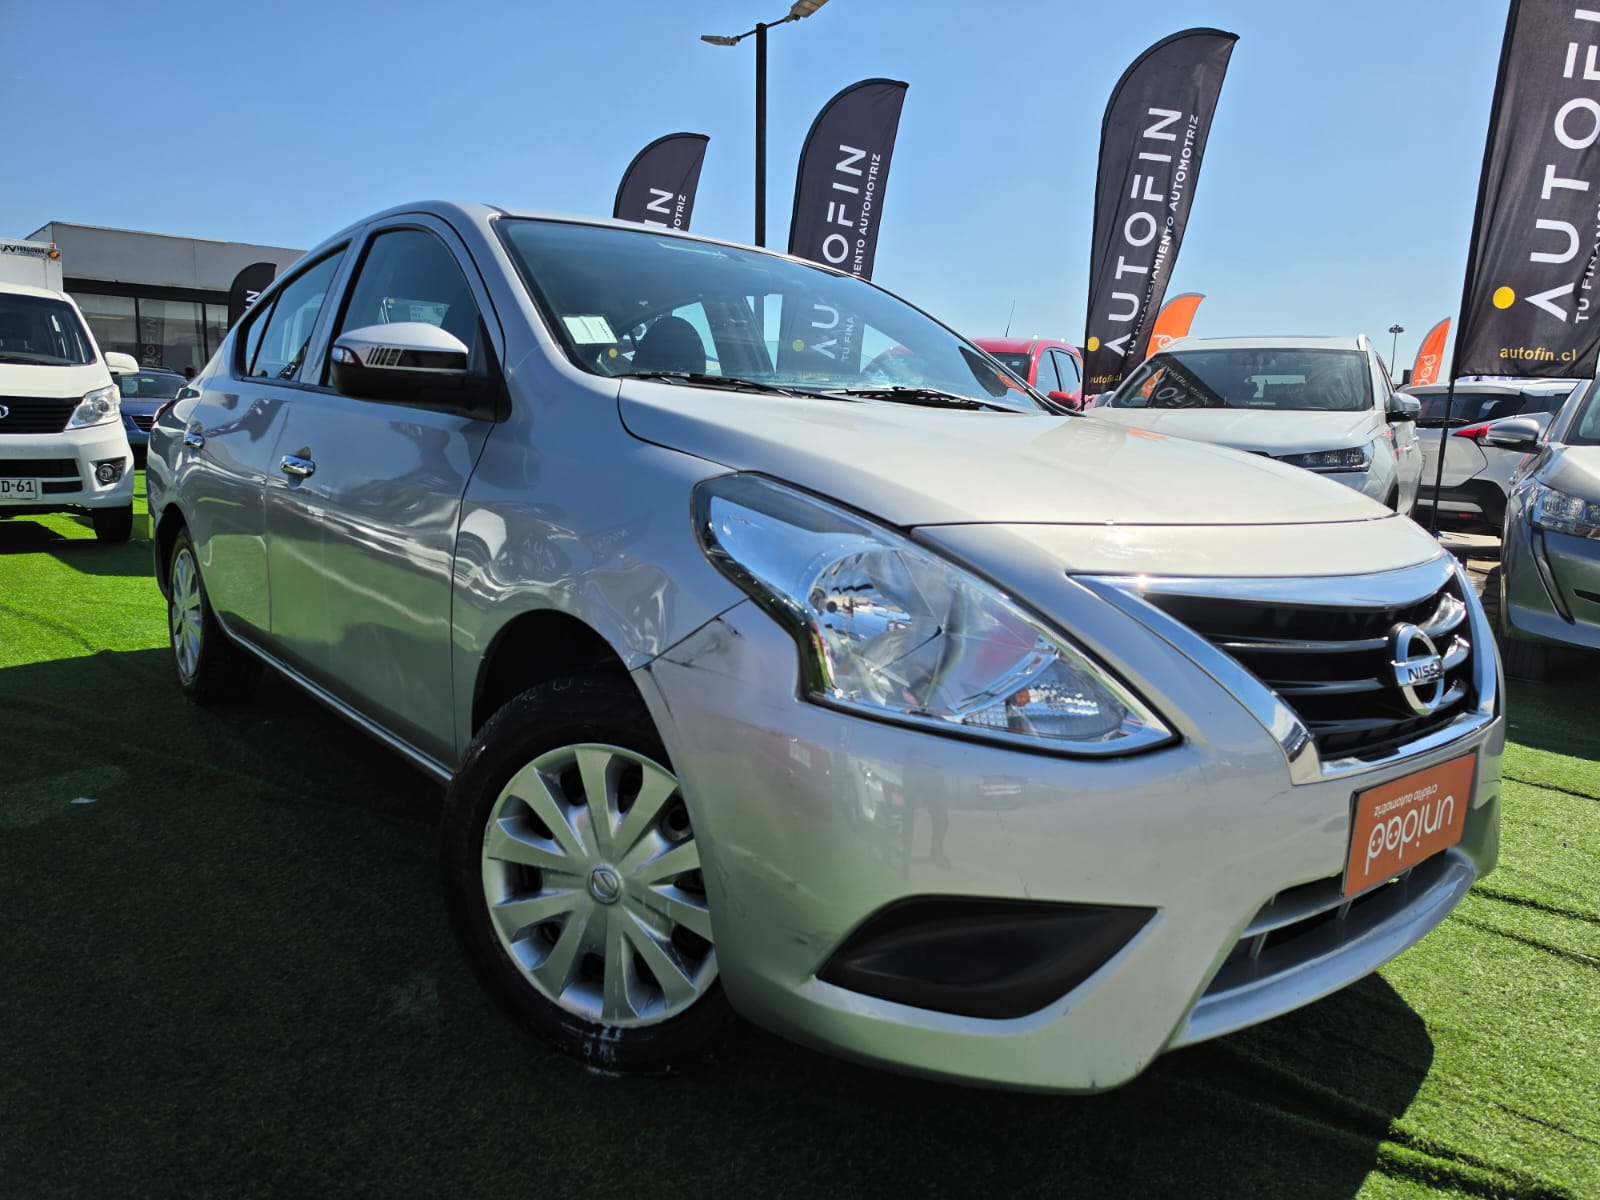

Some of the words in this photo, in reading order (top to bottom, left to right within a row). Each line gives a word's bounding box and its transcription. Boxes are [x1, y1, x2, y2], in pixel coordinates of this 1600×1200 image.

[859, 153, 881, 235] AUTOMOTRIZ
[1168, 113, 1199, 212] AUTOMOTRIZ
[1104, 107, 1183, 358] AUTOFIN
[1575, 298, 1590, 324] TU
[1500, 346, 1577, 362] autofin.cl
[1364, 795, 1454, 876] unidad
